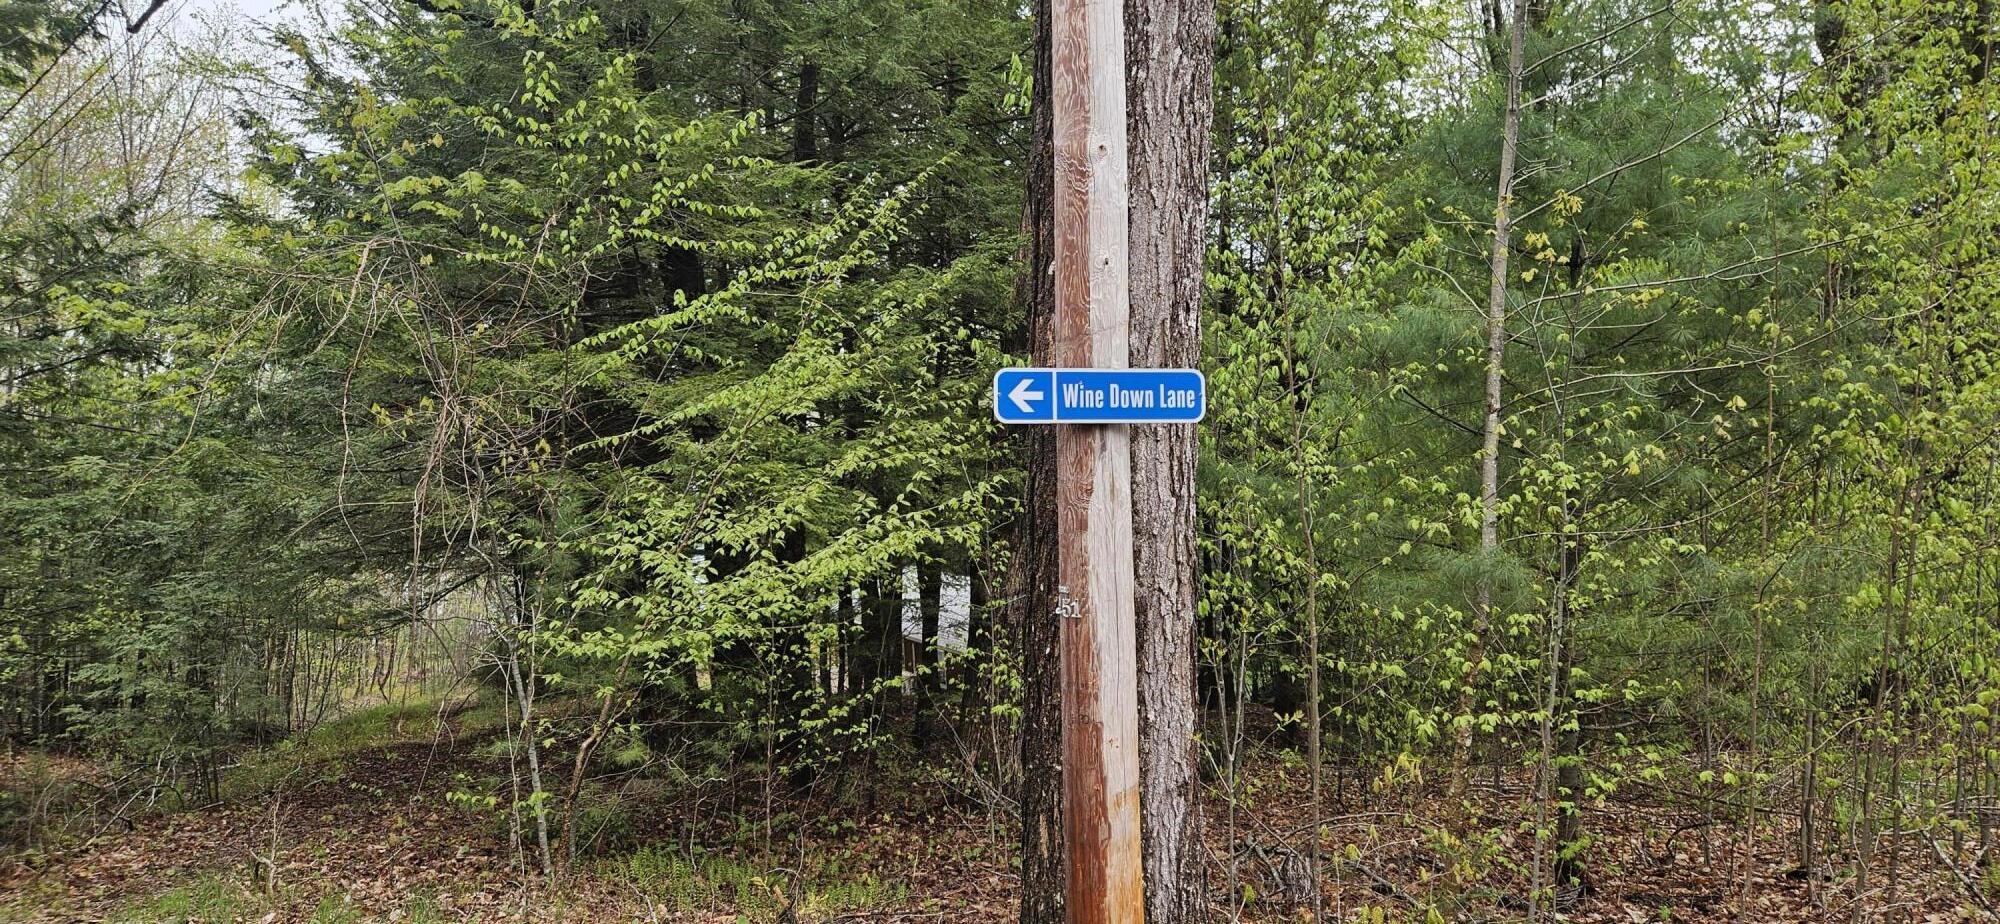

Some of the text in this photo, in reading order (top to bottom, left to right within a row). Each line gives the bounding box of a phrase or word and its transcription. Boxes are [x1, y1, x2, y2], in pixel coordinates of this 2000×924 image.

[1062, 382, 1196, 409] Wine Down Lane
